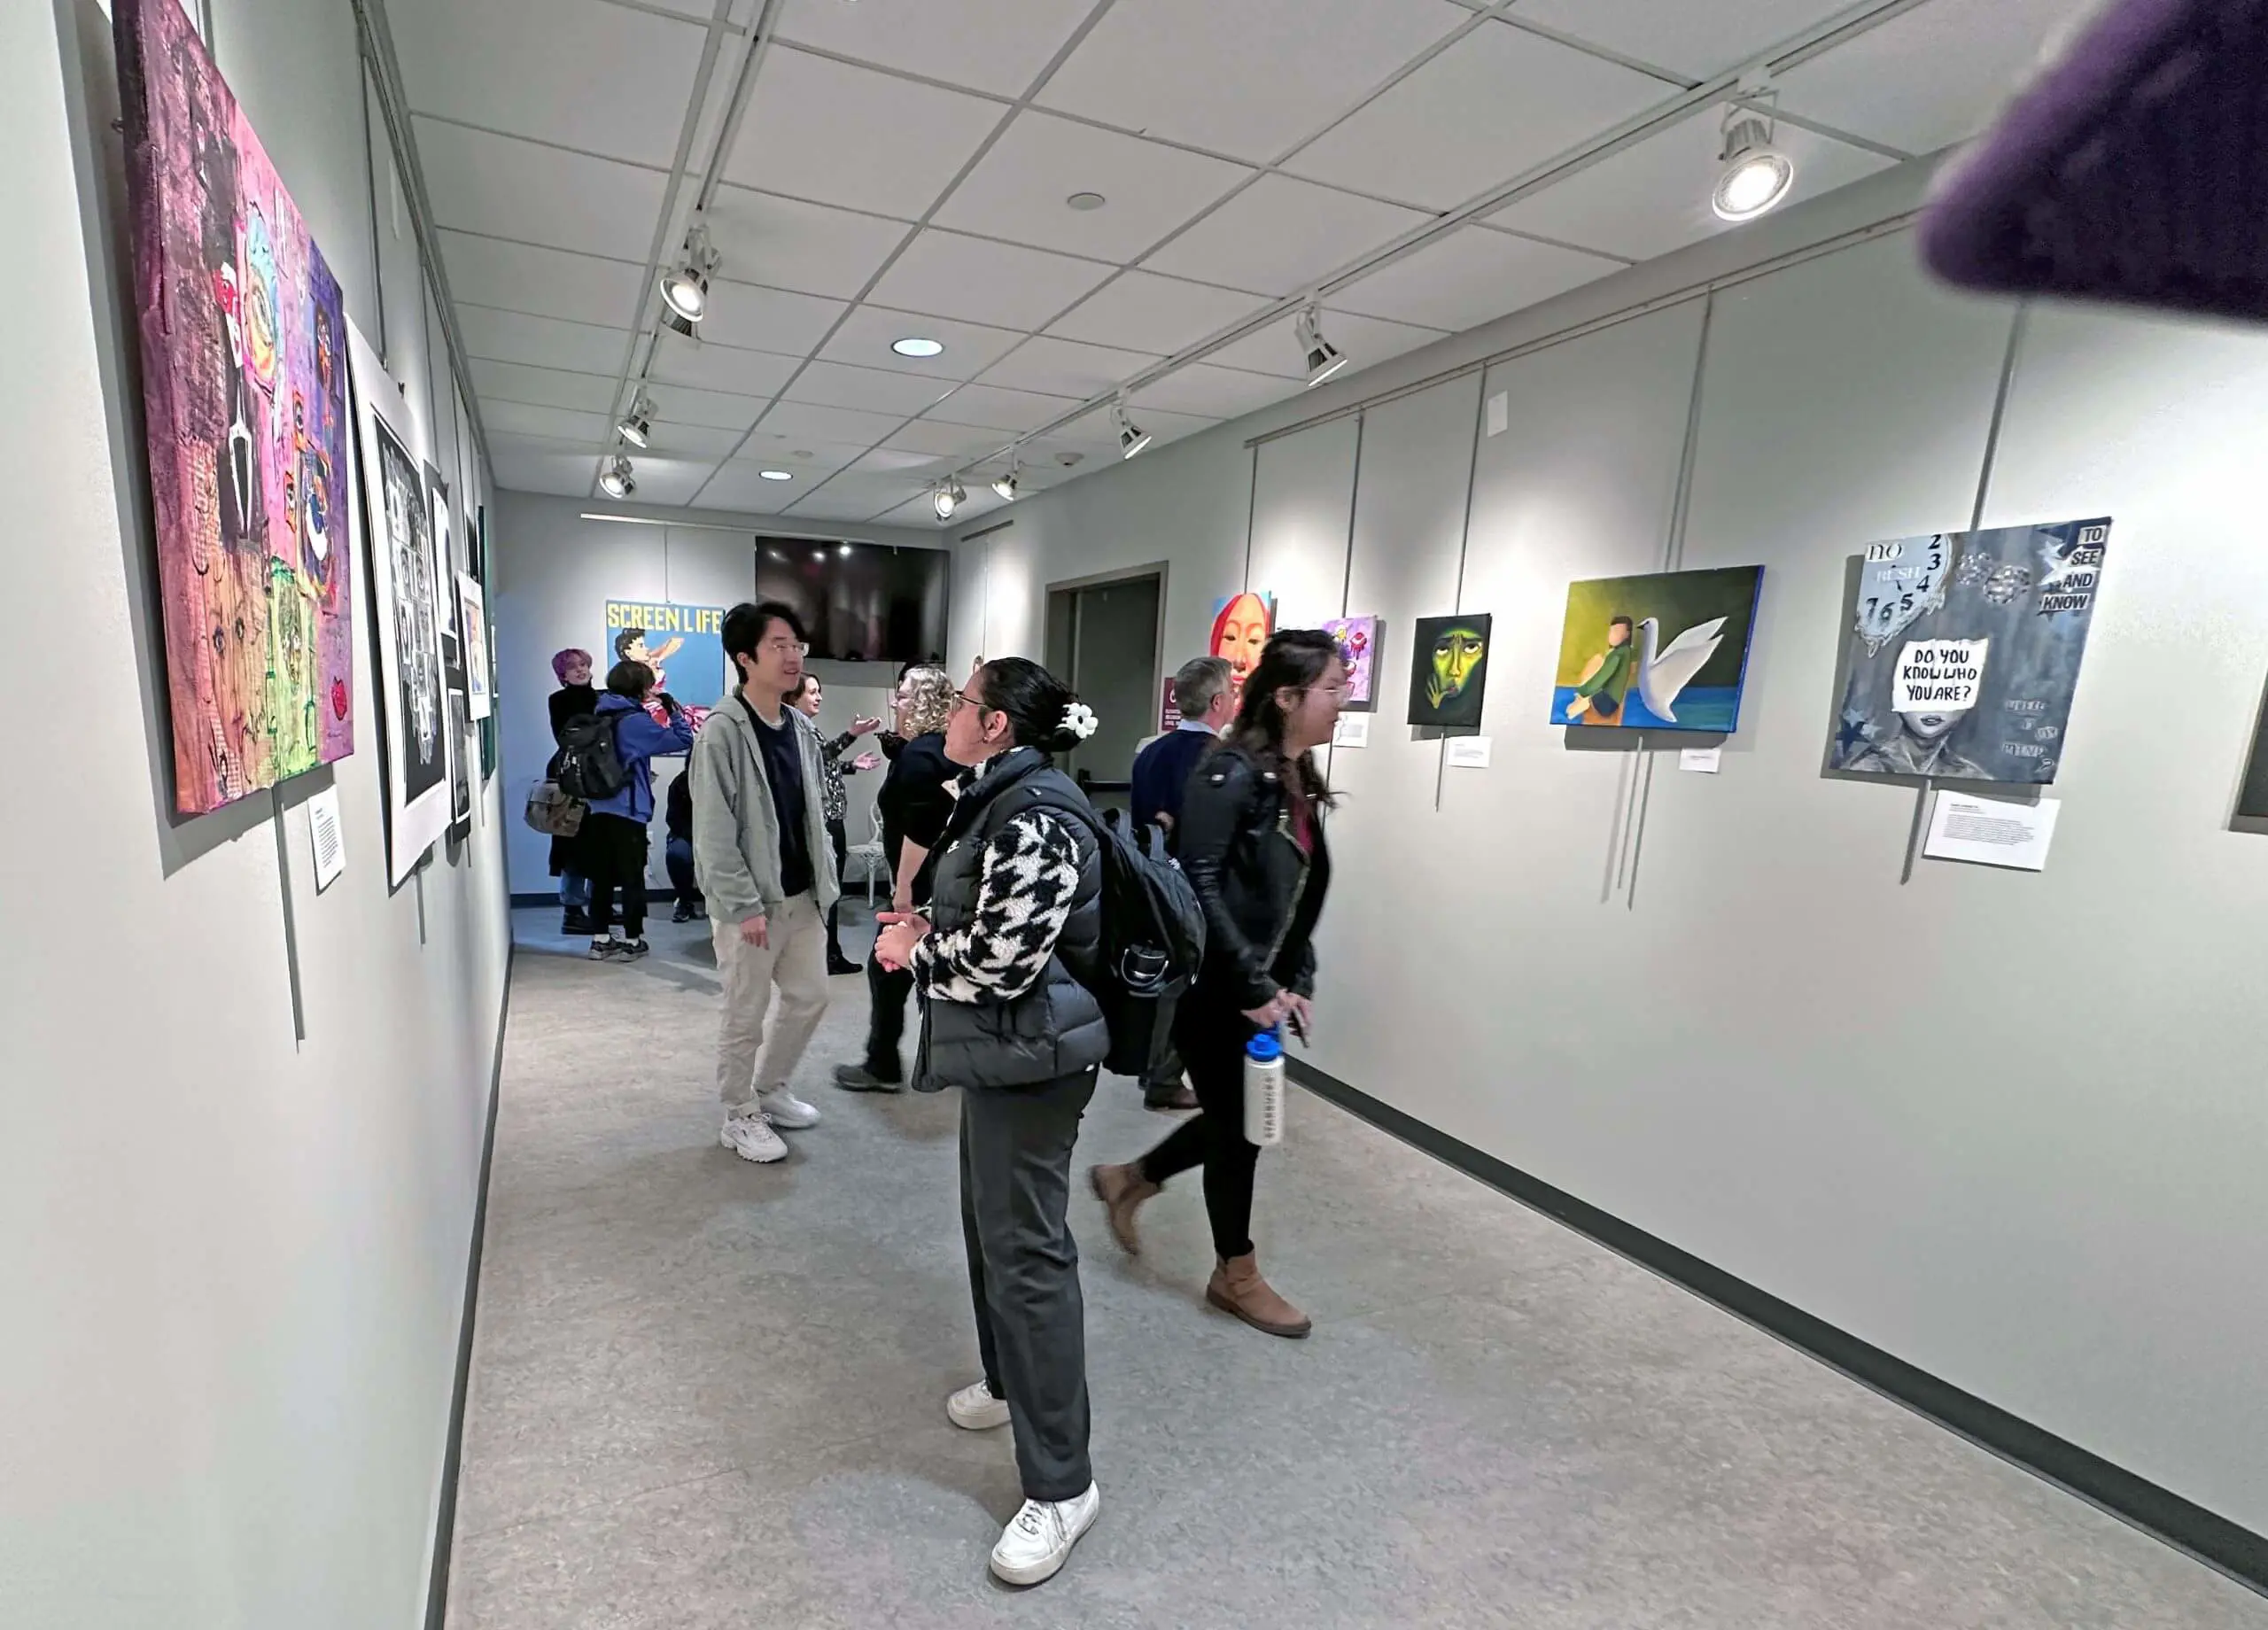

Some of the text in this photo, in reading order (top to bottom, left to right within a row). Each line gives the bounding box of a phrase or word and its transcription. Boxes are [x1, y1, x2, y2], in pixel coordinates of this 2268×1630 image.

[1928, 534, 1942, 550] 2
[2083, 527, 2103, 543] TO
[1926, 553, 1942, 571] 3
[2070, 550, 2099, 565] SEE
[1915, 574, 1930, 593] 4
[2062, 573, 2093, 588] AND
[1866, 597, 1879, 619] 7
[1899, 593, 1914, 611] 5
[2042, 594, 2088, 609] KNOW
[607, 602, 722, 635] SCREEN LIFE
[1880, 602, 1895, 621] 6
[1915, 649, 1969, 664] DO YOU
[1943, 667, 1977, 680] WHO
[1906, 685, 1932, 702] YOU
